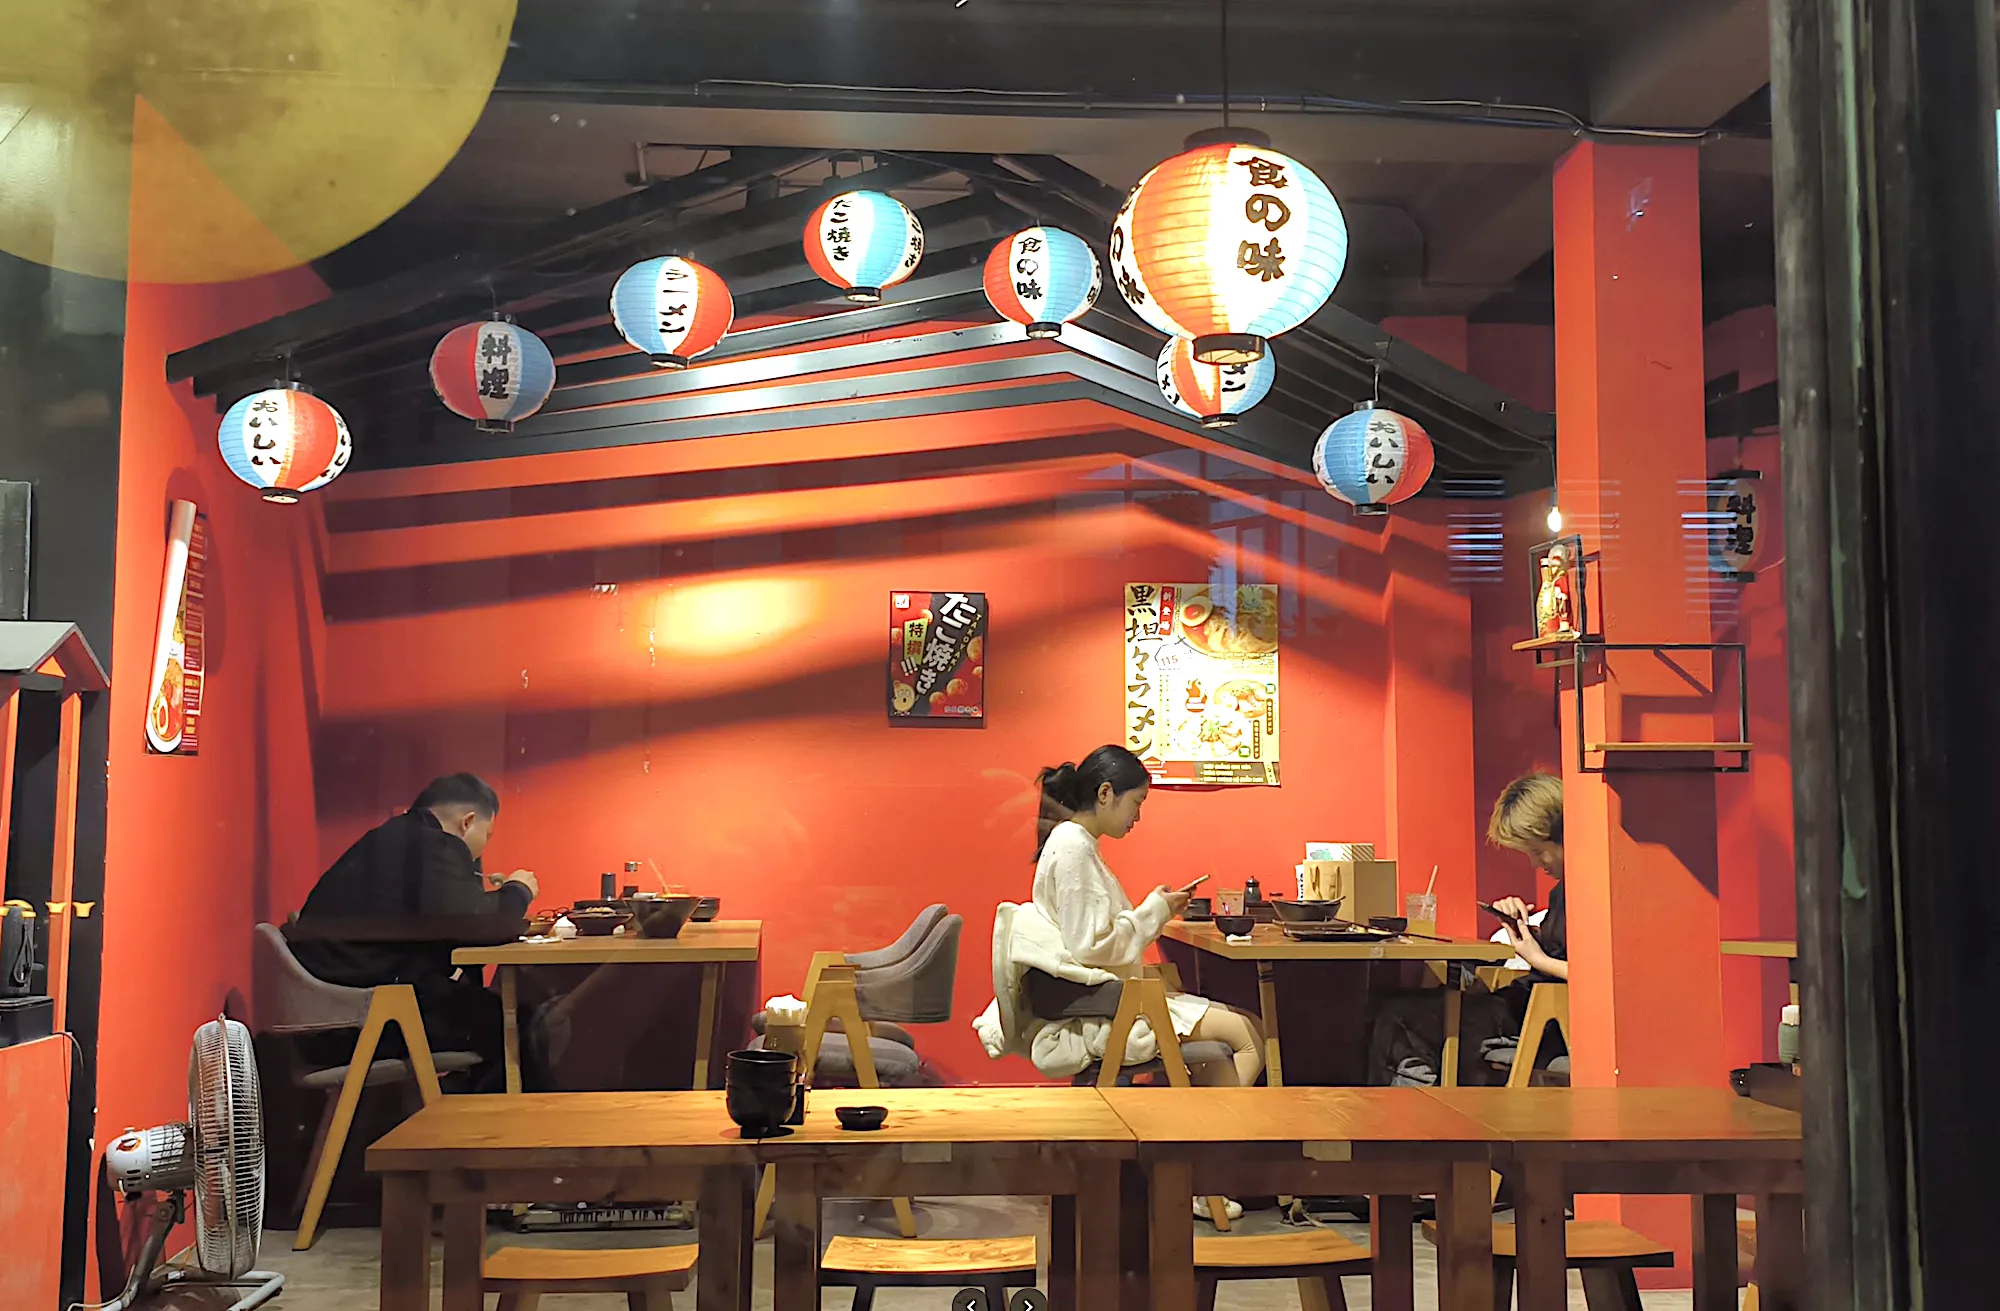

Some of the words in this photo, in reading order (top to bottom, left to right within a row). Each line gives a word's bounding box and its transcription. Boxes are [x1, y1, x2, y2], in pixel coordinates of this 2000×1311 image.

[827, 199, 853, 261] たこ焼き
[1234, 157, 1292, 282] 食の味
[658, 268, 689, 333] ラーメン
[1016, 237, 1043, 300] 食の味
[479, 333, 512, 399] 料理
[1222, 362, 1249, 393] メン
[249, 400, 281, 466] おいしい
[1365, 421, 1399, 484] おいしい
[917, 592, 978, 695] たこ焼き
[1160, 655, 1179, 666] 115
